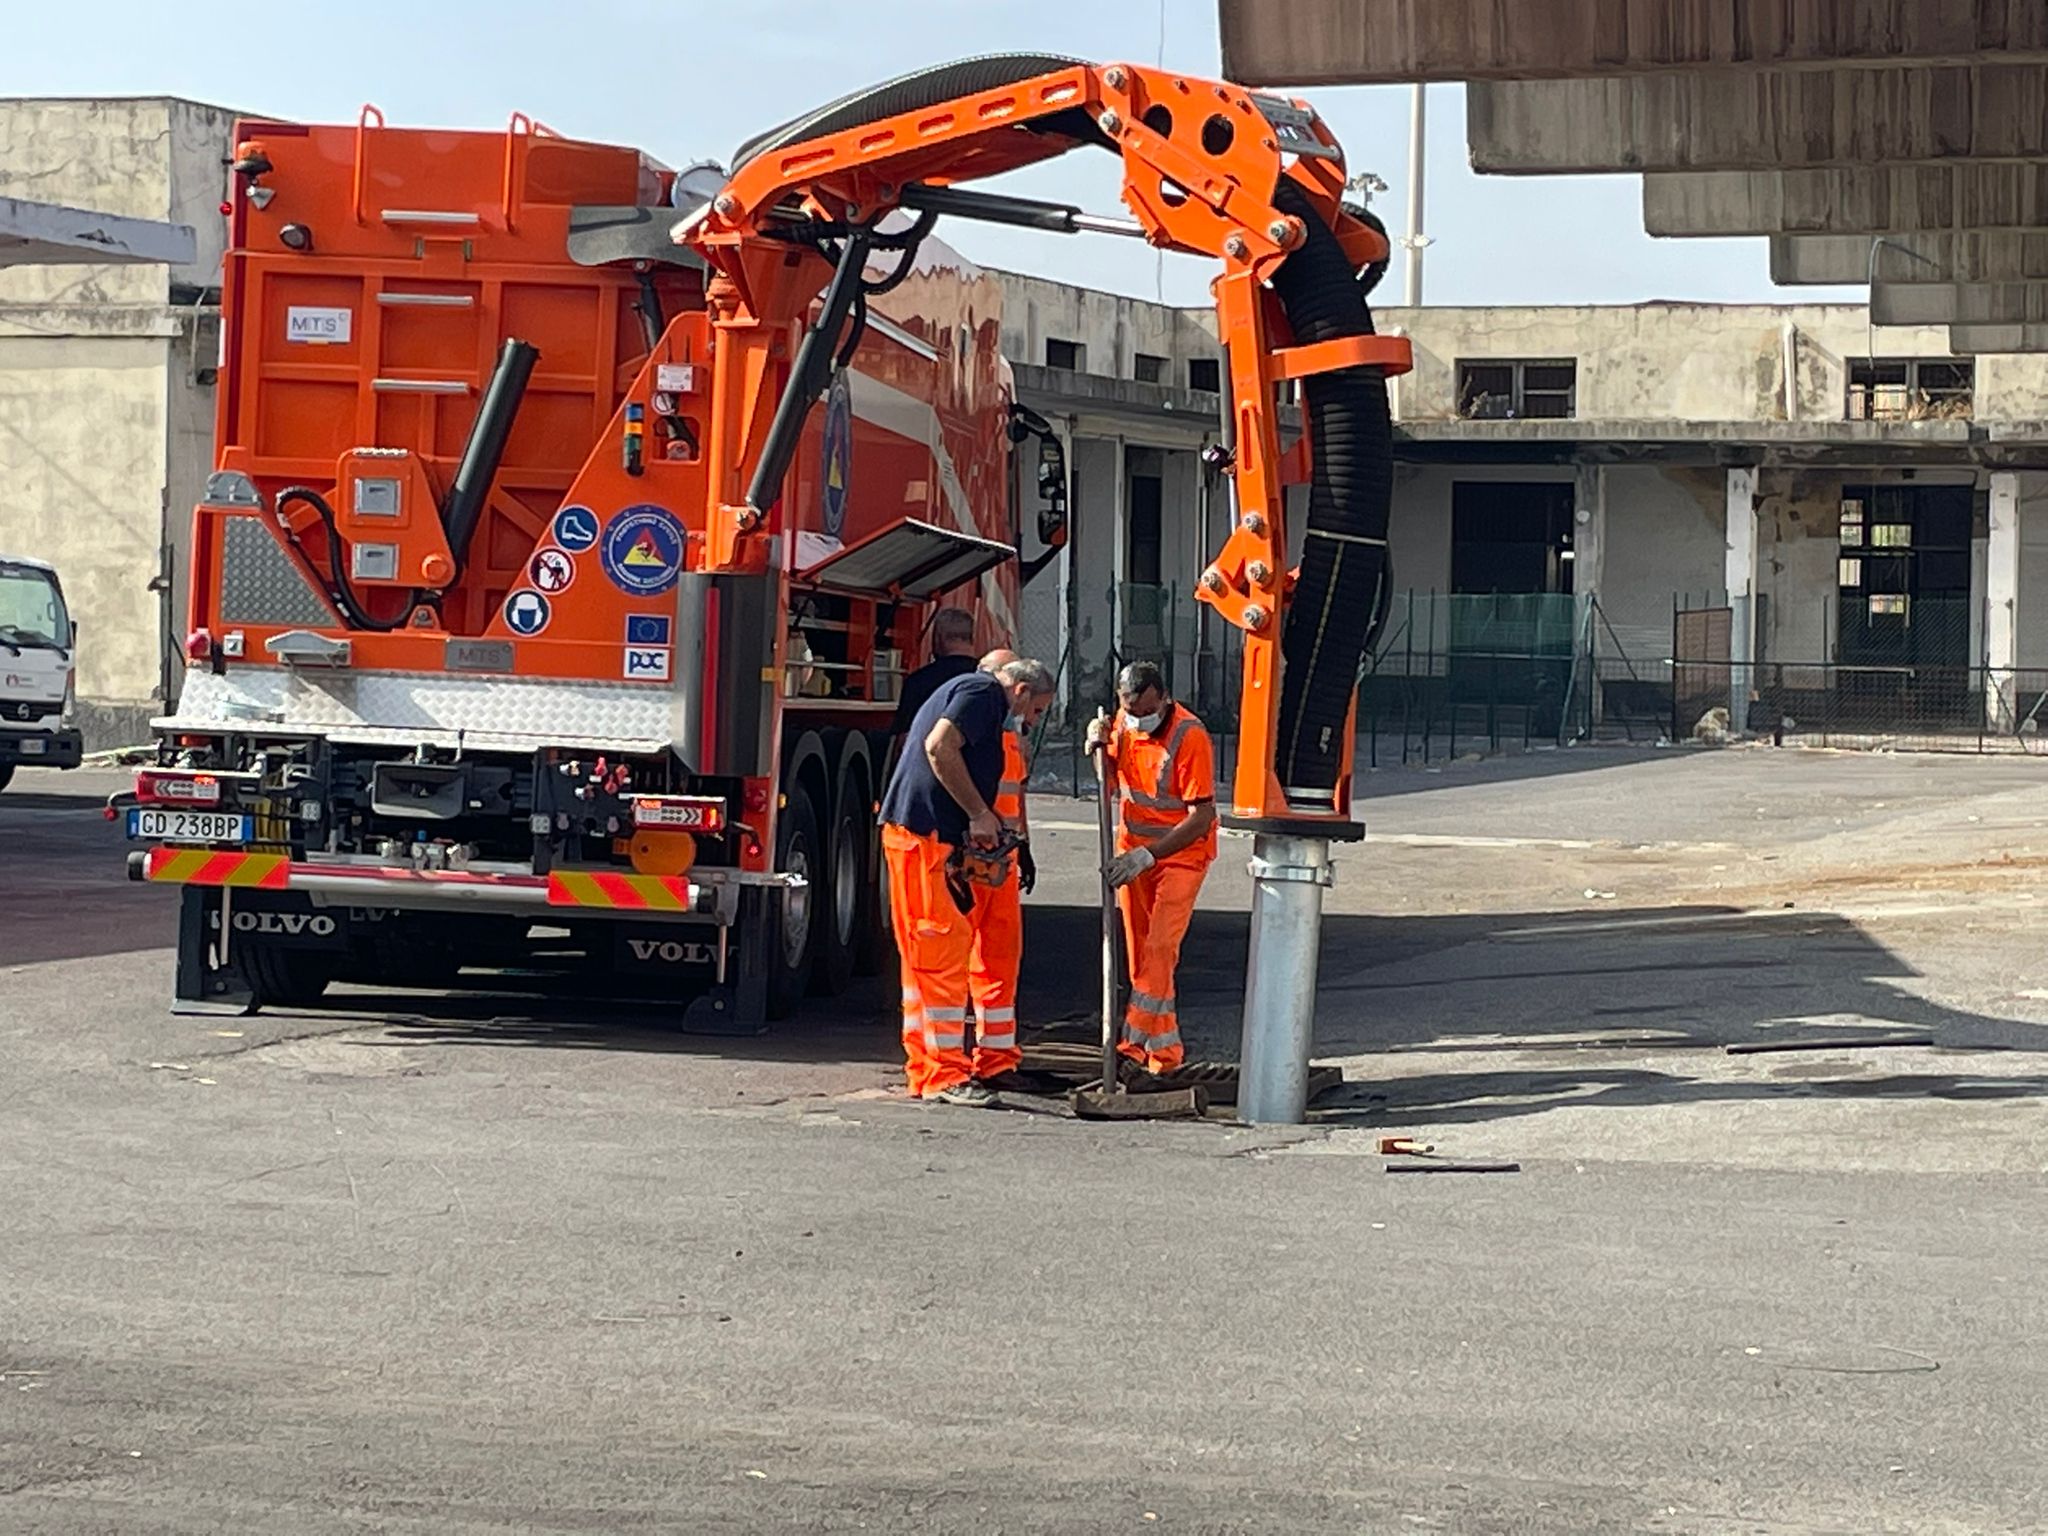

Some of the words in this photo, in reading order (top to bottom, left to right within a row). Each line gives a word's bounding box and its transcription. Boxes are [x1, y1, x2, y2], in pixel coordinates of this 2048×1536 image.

[292, 316, 336, 332] MTS
[459, 648, 500, 663] MTS
[142, 813, 168, 834] GD
[627, 939, 739, 963] VOLV
